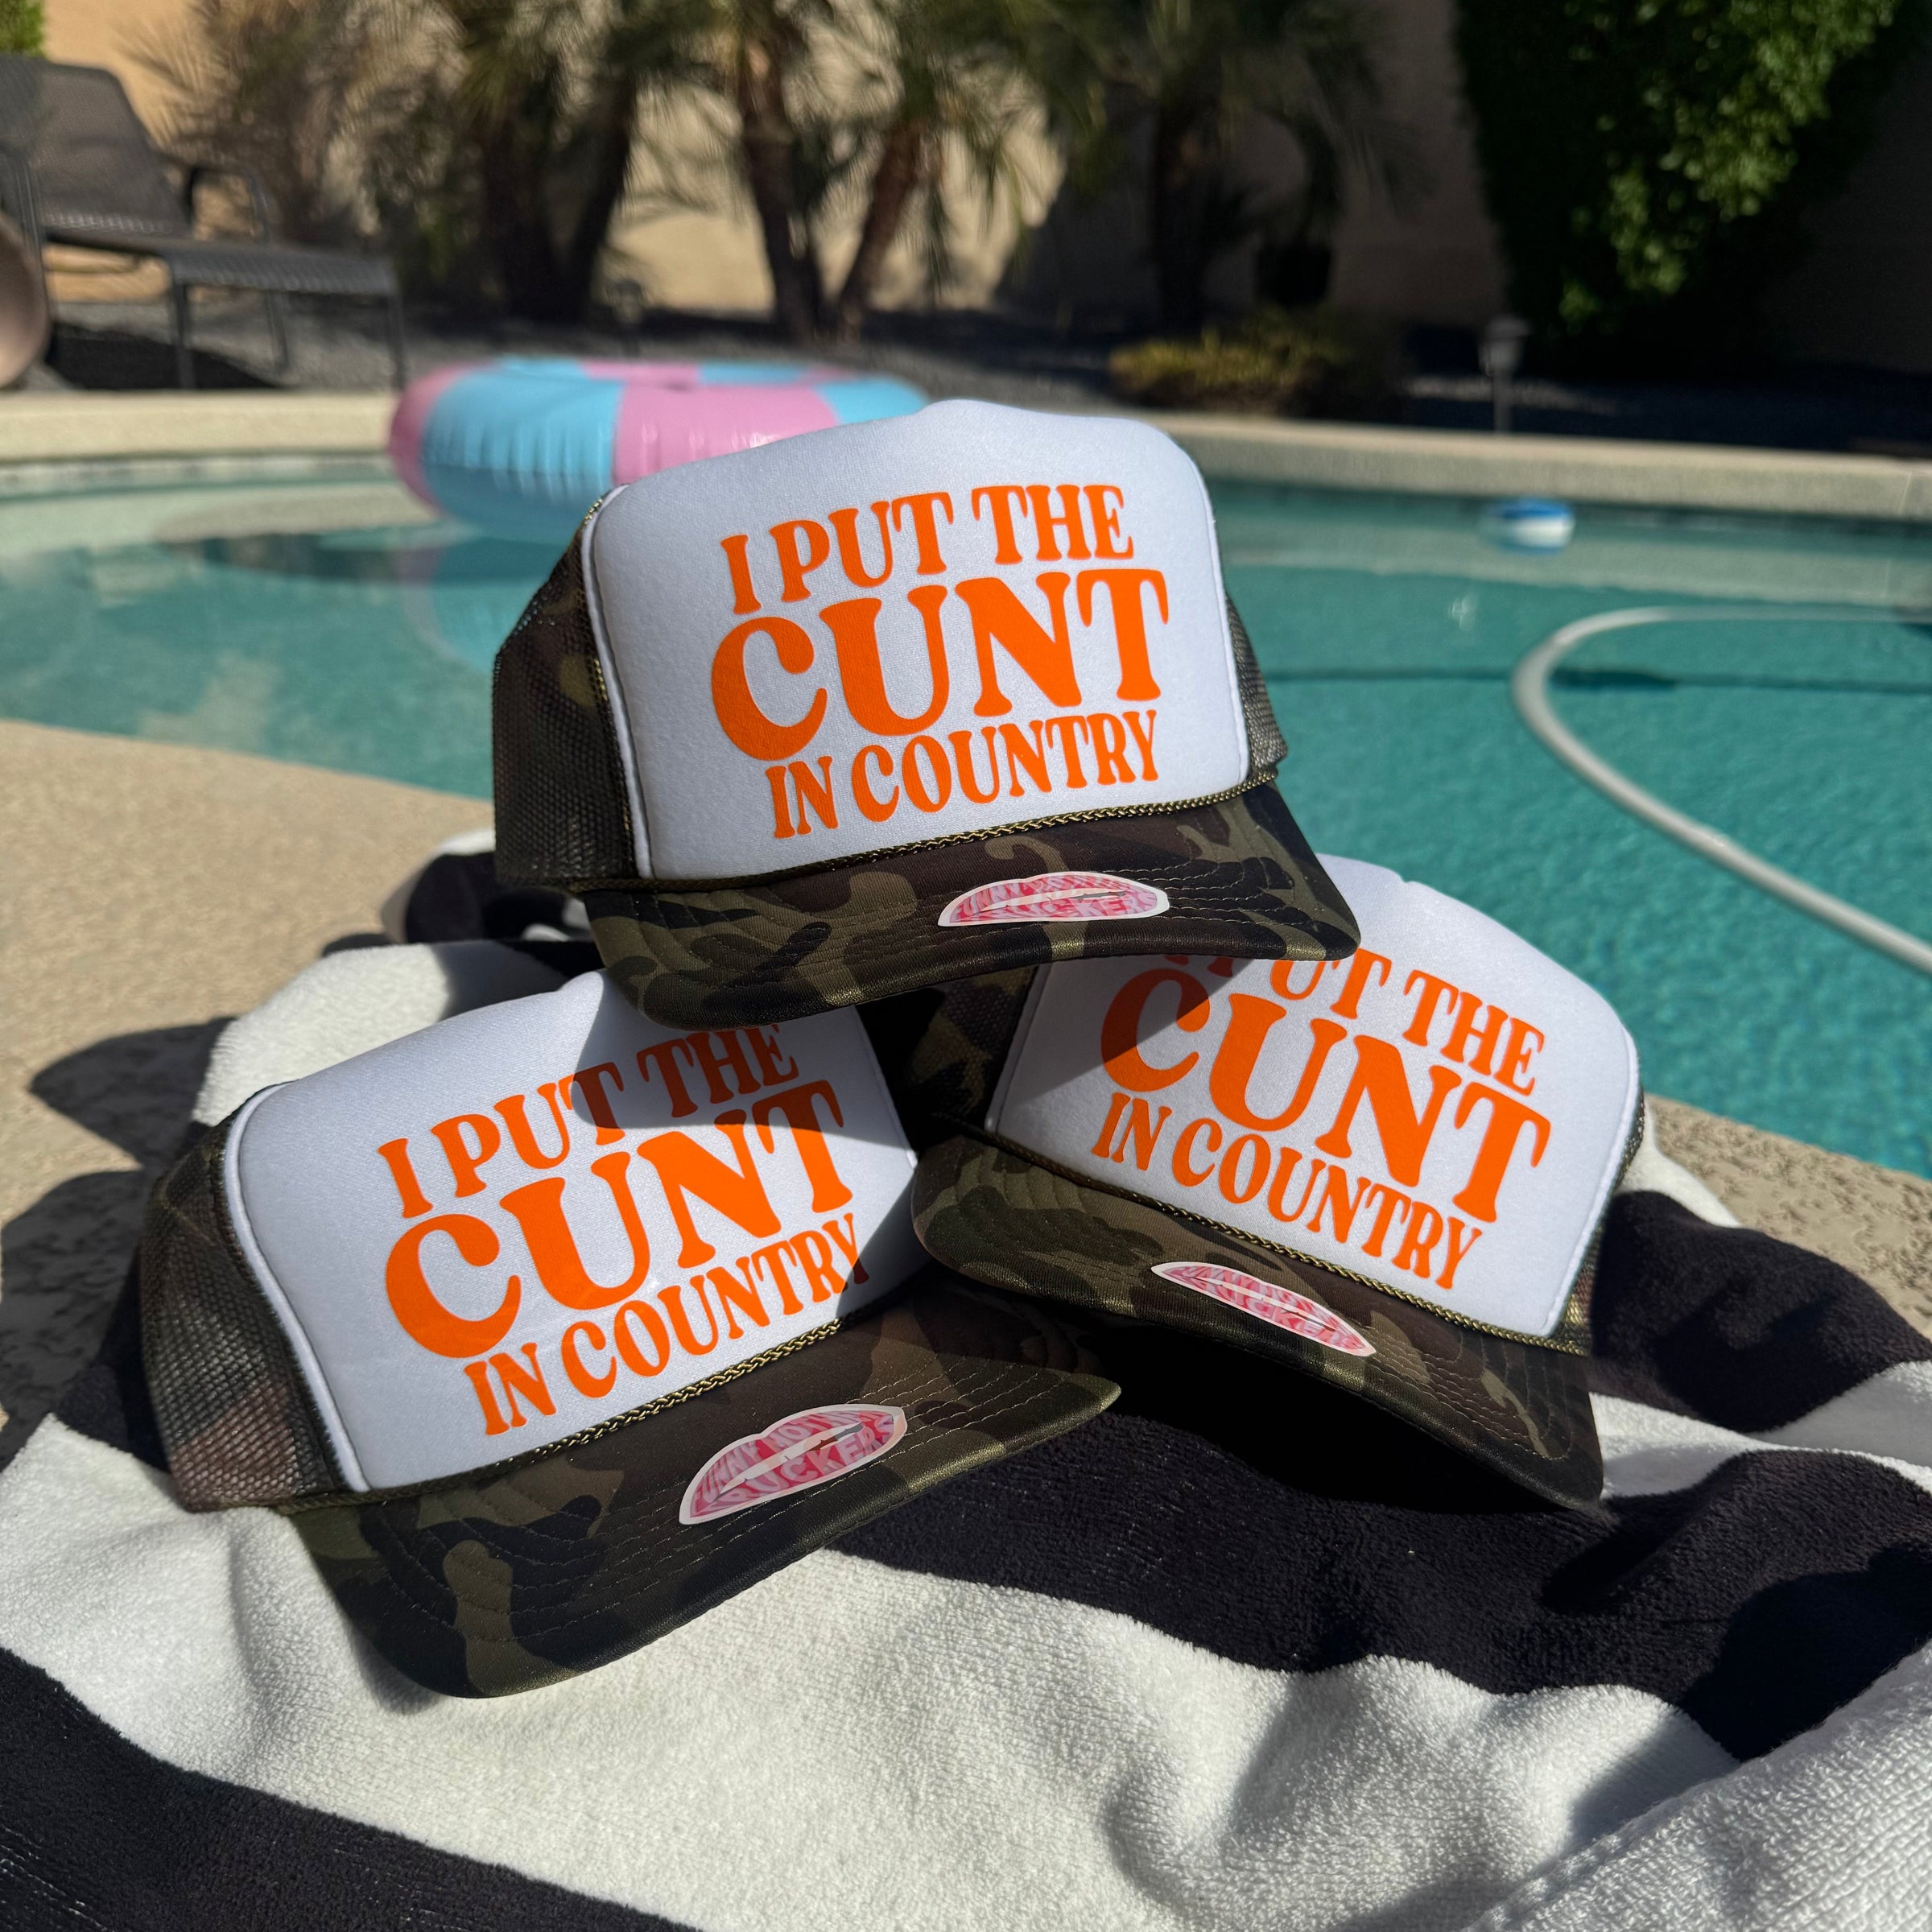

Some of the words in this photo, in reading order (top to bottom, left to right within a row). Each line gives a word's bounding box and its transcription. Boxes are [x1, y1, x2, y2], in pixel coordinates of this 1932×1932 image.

[720, 534, 761, 614] I
[769, 492, 953, 601] PUT
[972, 485, 1134, 564] THE
[711, 568, 1169, 761] CUNT
[766, 756, 838, 839] IN
[852, 710, 1158, 822] COUNTRY
[1100, 968, 1550, 1222] CUNT
[1208, 949, 1391, 1019] UT
[1403, 970, 1544, 1096] THE
[378, 1137, 433, 1218] I
[431, 1062, 625, 1198] PUT
[637, 1023, 799, 1118] THE
[1092, 1092, 1172, 1170] IN
[1172, 1118, 1482, 1290] COUNTRY
[386, 1080, 853, 1358] CUNT
[464, 1343, 557, 1435] IN
[561, 1212, 869, 1398] COUNTRY
